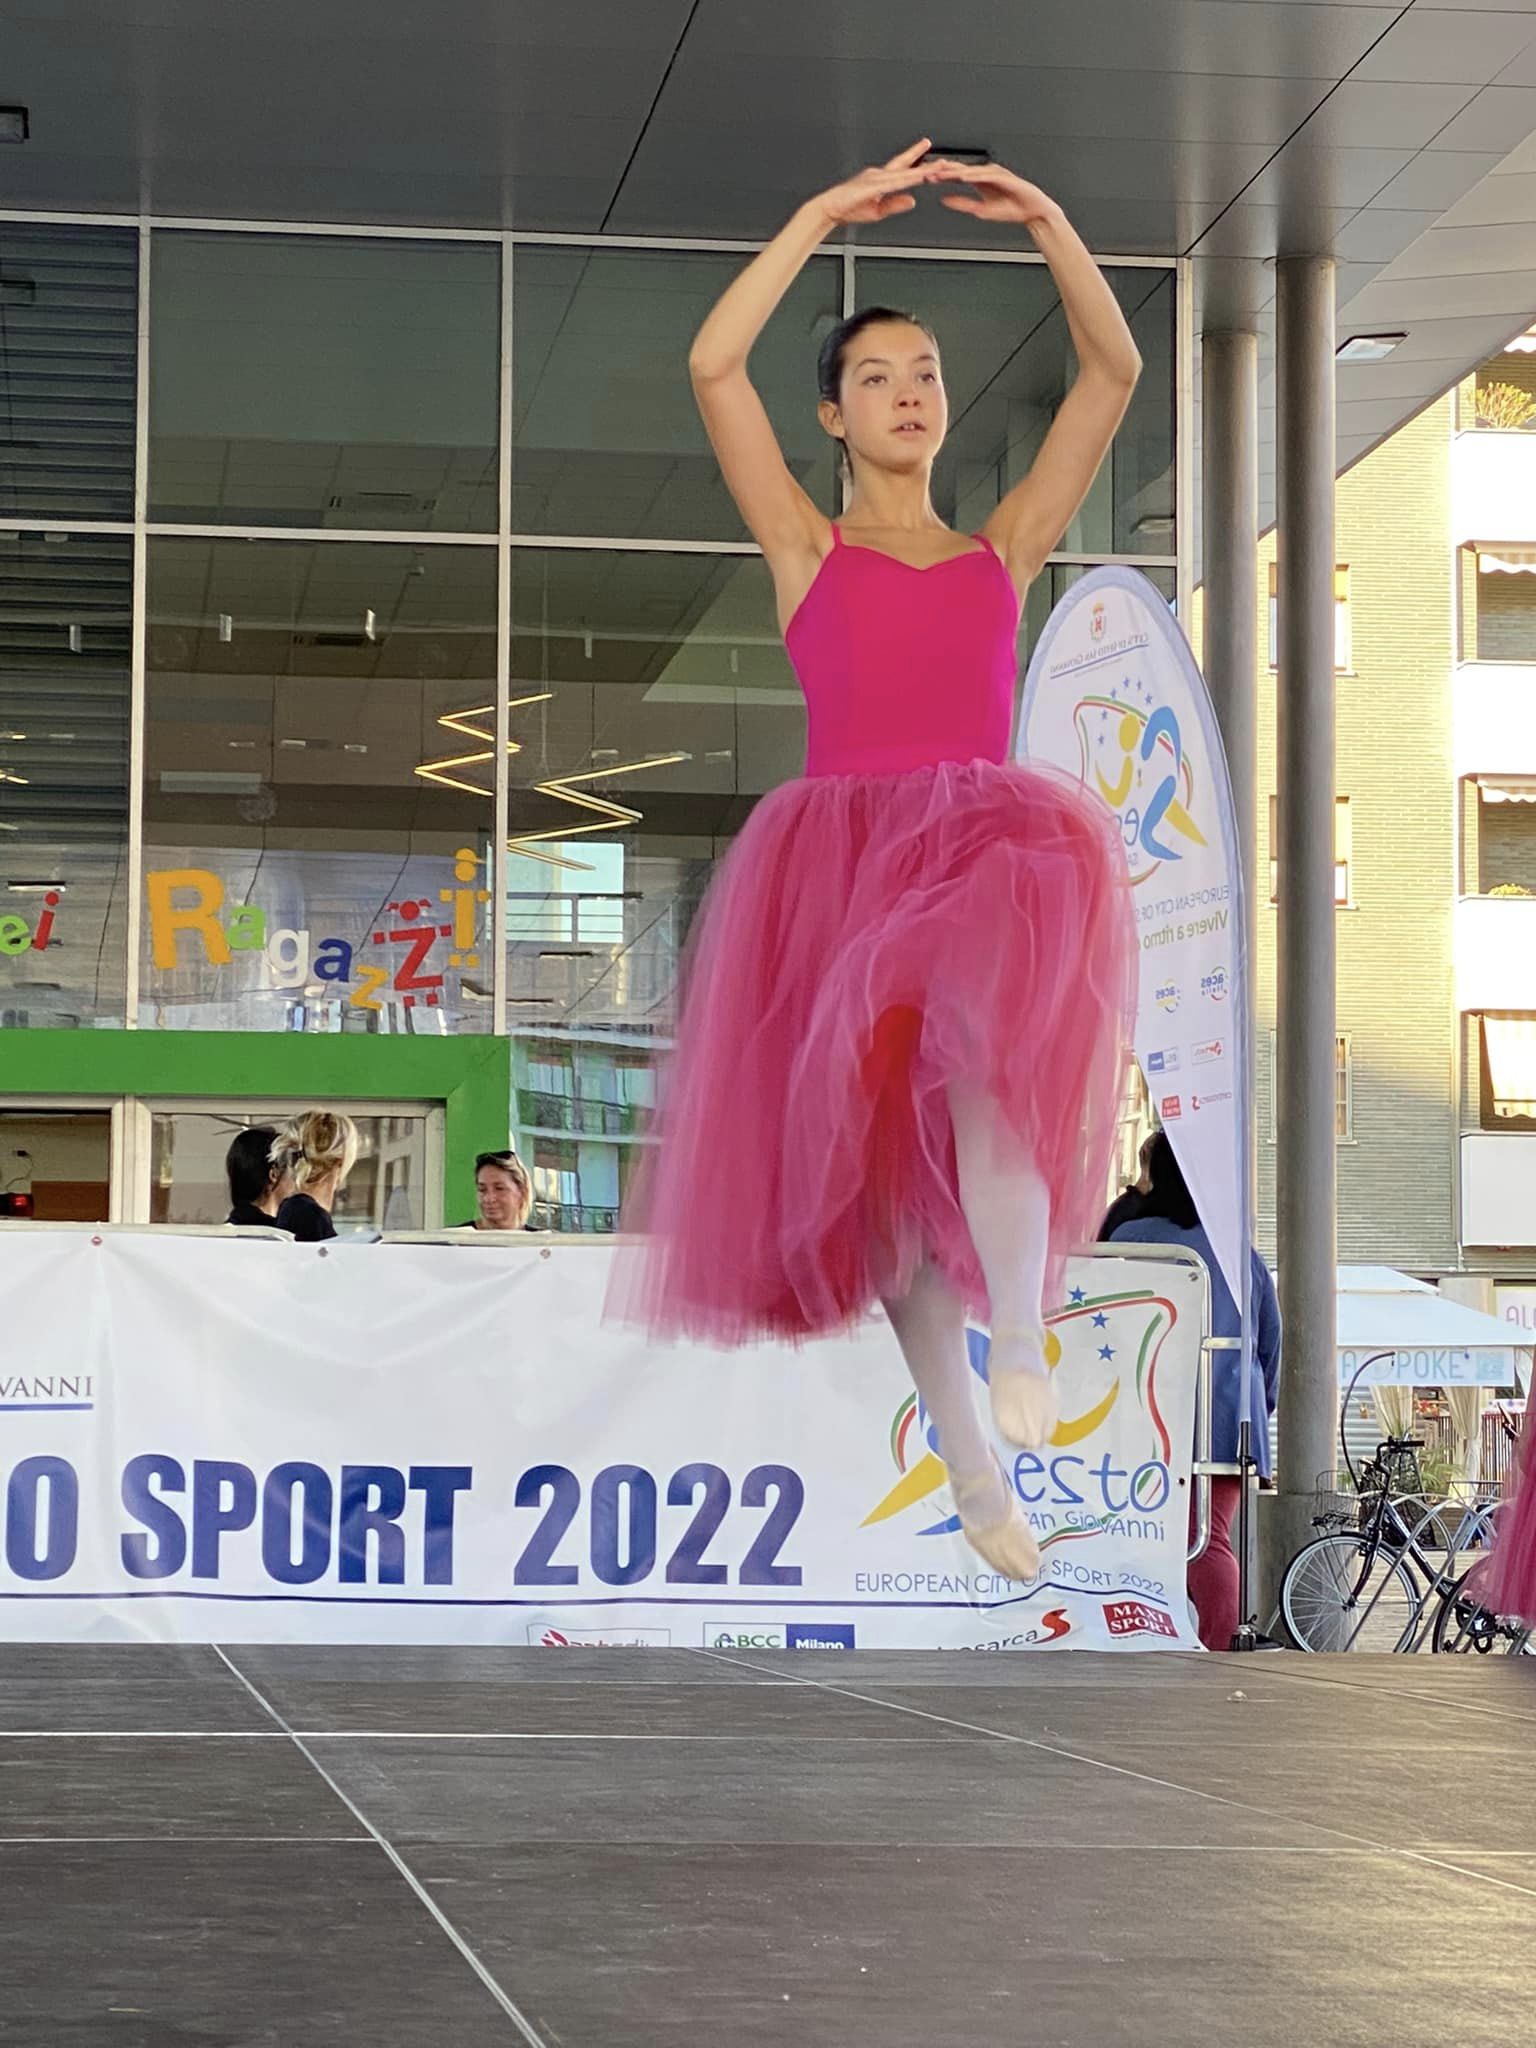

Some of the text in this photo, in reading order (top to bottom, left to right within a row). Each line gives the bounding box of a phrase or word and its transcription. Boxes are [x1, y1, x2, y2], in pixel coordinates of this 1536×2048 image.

[1396, 1351, 1465, 1379] POKE
[6, 1454, 804, 1587] O SPORT 2022
[855, 1573, 969, 1593] EUROPEAN
[974, 1574, 1013, 1593] CITY
[1051, 1559, 1112, 1586] SPORT
[1119, 1572, 1165, 1597] 2022
[1110, 1617, 1173, 1635] SPORT
[1113, 1604, 1165, 1624] MAXI
[737, 1634, 782, 1648] BCC
